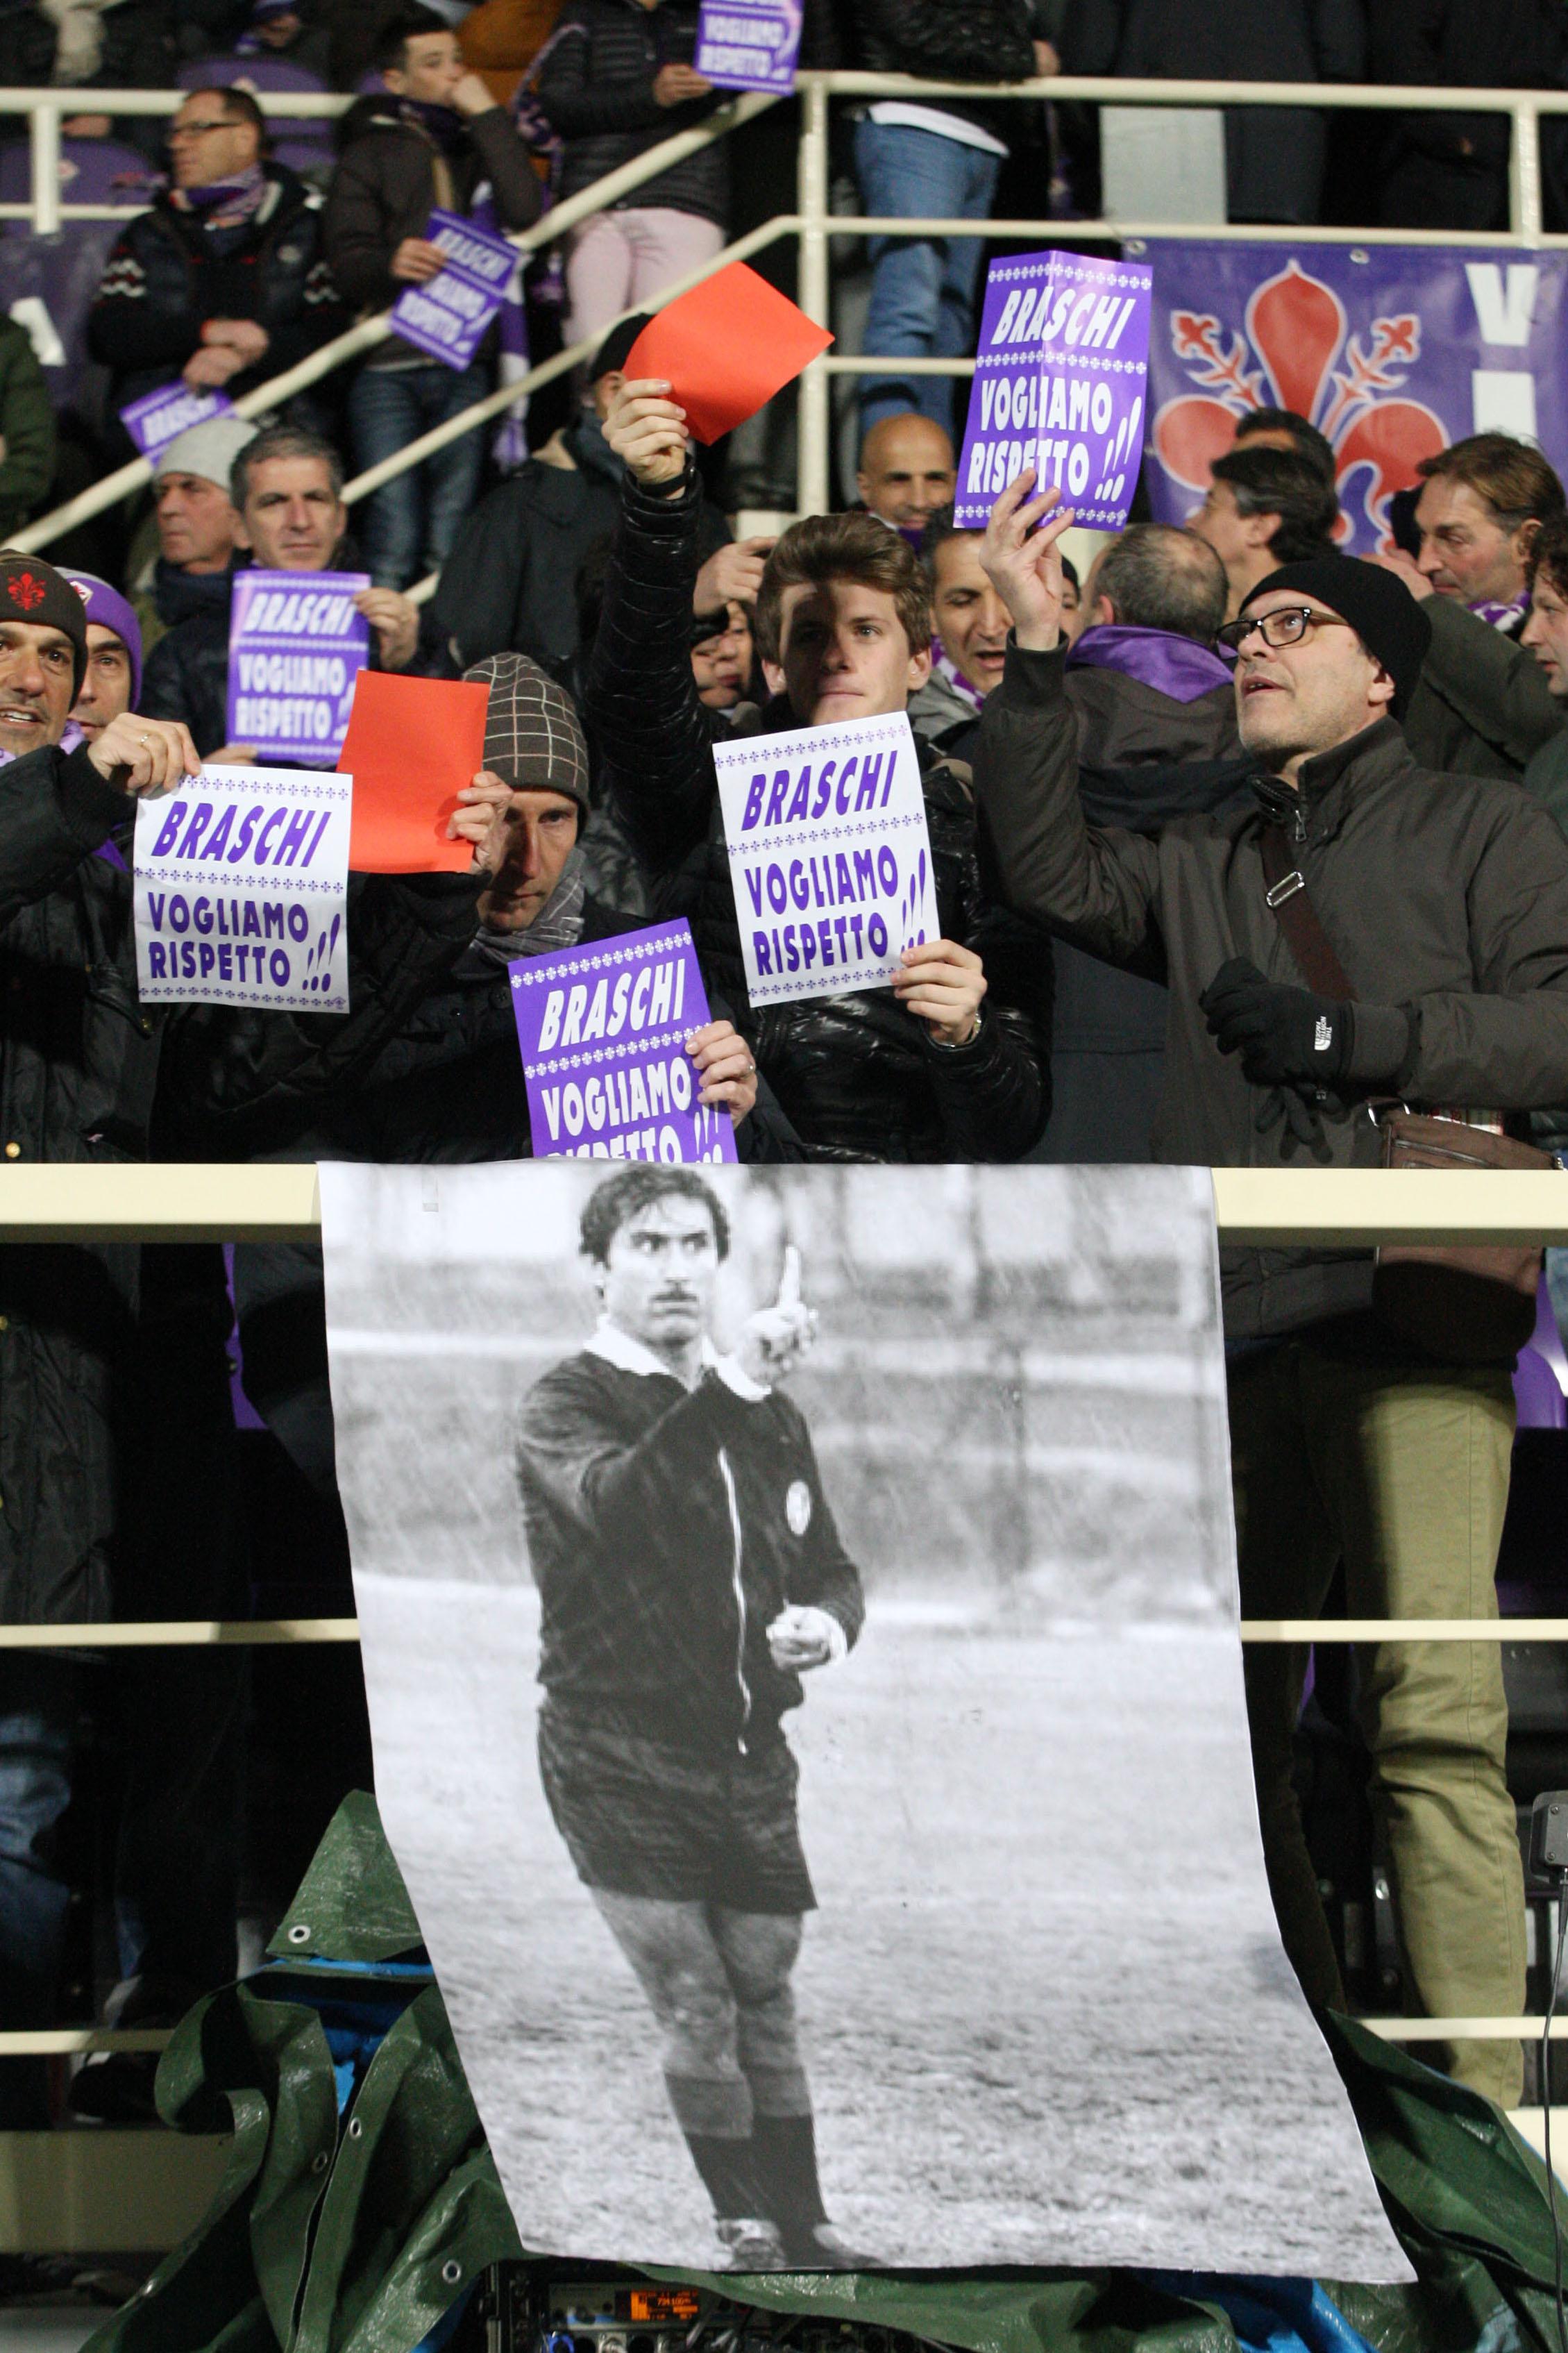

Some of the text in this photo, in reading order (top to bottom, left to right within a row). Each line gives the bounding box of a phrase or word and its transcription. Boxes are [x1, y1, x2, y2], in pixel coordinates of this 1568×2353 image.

[990, 285, 1136, 351] BRASCHI
[980, 376, 1113, 435] VOGLIAMO
[242, 592, 357, 635] BRASCHI
[238, 653, 346, 696] VOGLIAMO
[234, 696, 333, 739] RISPETTO
[741, 750, 898, 832] BRASCHI
[151, 801, 332, 868] BRASCHI
[744, 844, 899, 918] VOGLIAMO
[147, 891, 309, 943] VOGLIAMO
[752, 912, 888, 976] RISPETTO
[149, 941, 291, 987] RISPETTO
[537, 958, 686, 1053] BRASCHI
[541, 1056, 692, 1141] VOGLIAMO
